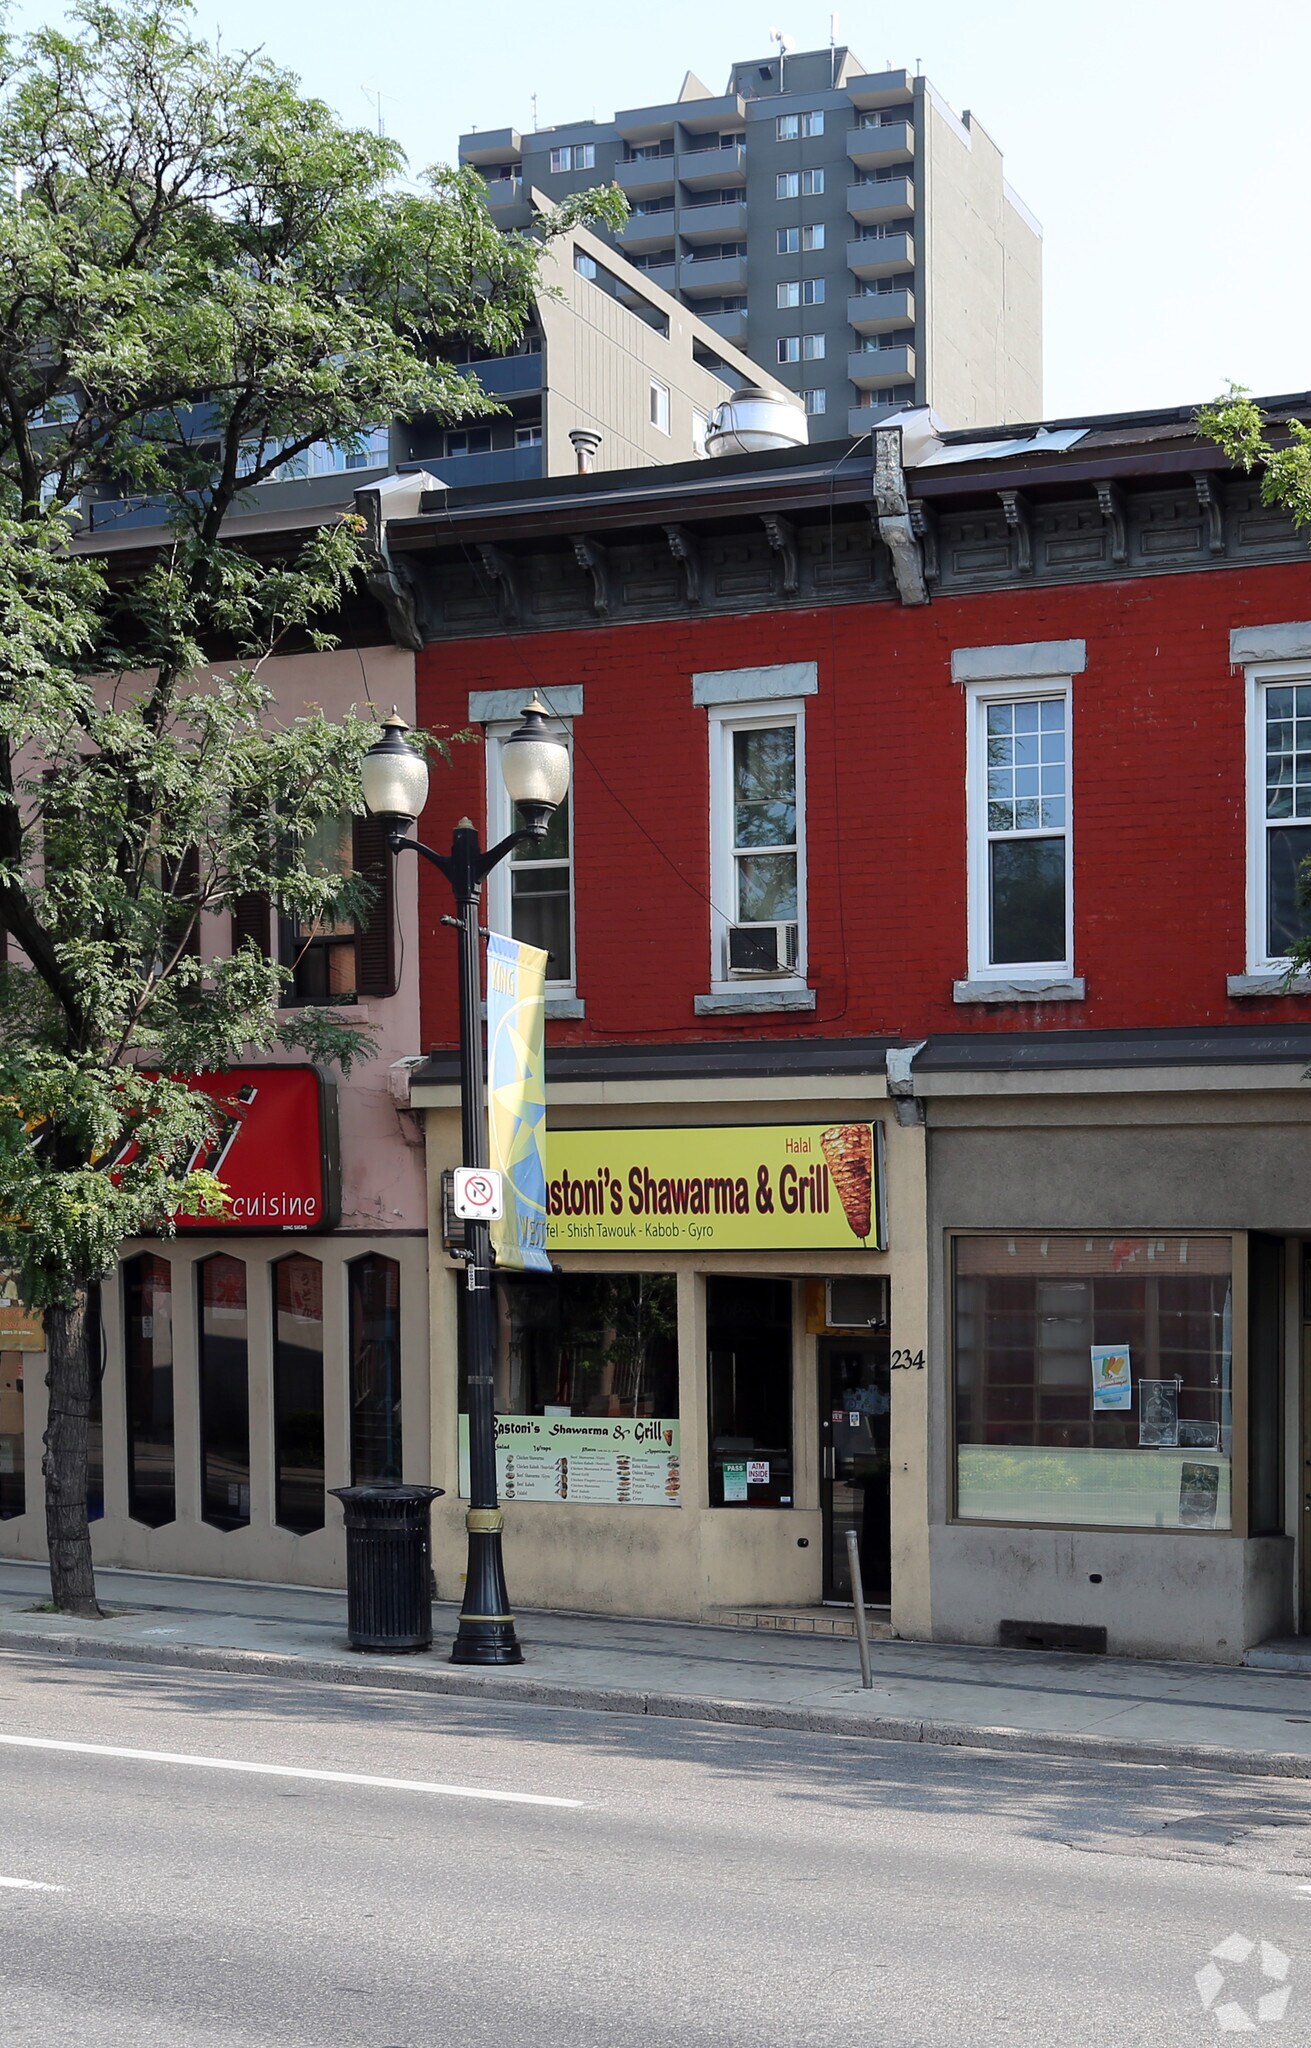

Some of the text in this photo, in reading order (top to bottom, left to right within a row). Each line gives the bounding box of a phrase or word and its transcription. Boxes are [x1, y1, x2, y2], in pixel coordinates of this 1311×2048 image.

[785, 1137, 812, 1154] Halal
[628, 1166, 750, 1216] Shawarma
[756, 1164, 775, 1214] &
[779, 1163, 829, 1214] Grill
[232, 1191, 317, 1217] cuisine
[567, 1222, 595, 1238] Shish
[596, 1222, 637, 1238] Tawouk
[645, 1222, 680, 1238] Kabob
[688, 1222, 714, 1241] Gyro
[890, 1349, 926, 1370] 234
[548, 1423, 609, 1437] Shawarma
[613, 1425, 631, 1440] &
[634, 1420, 662, 1444] Grill
[748, 1470, 768, 1478] INSIDE
[751, 1462, 765, 1470] ATM
